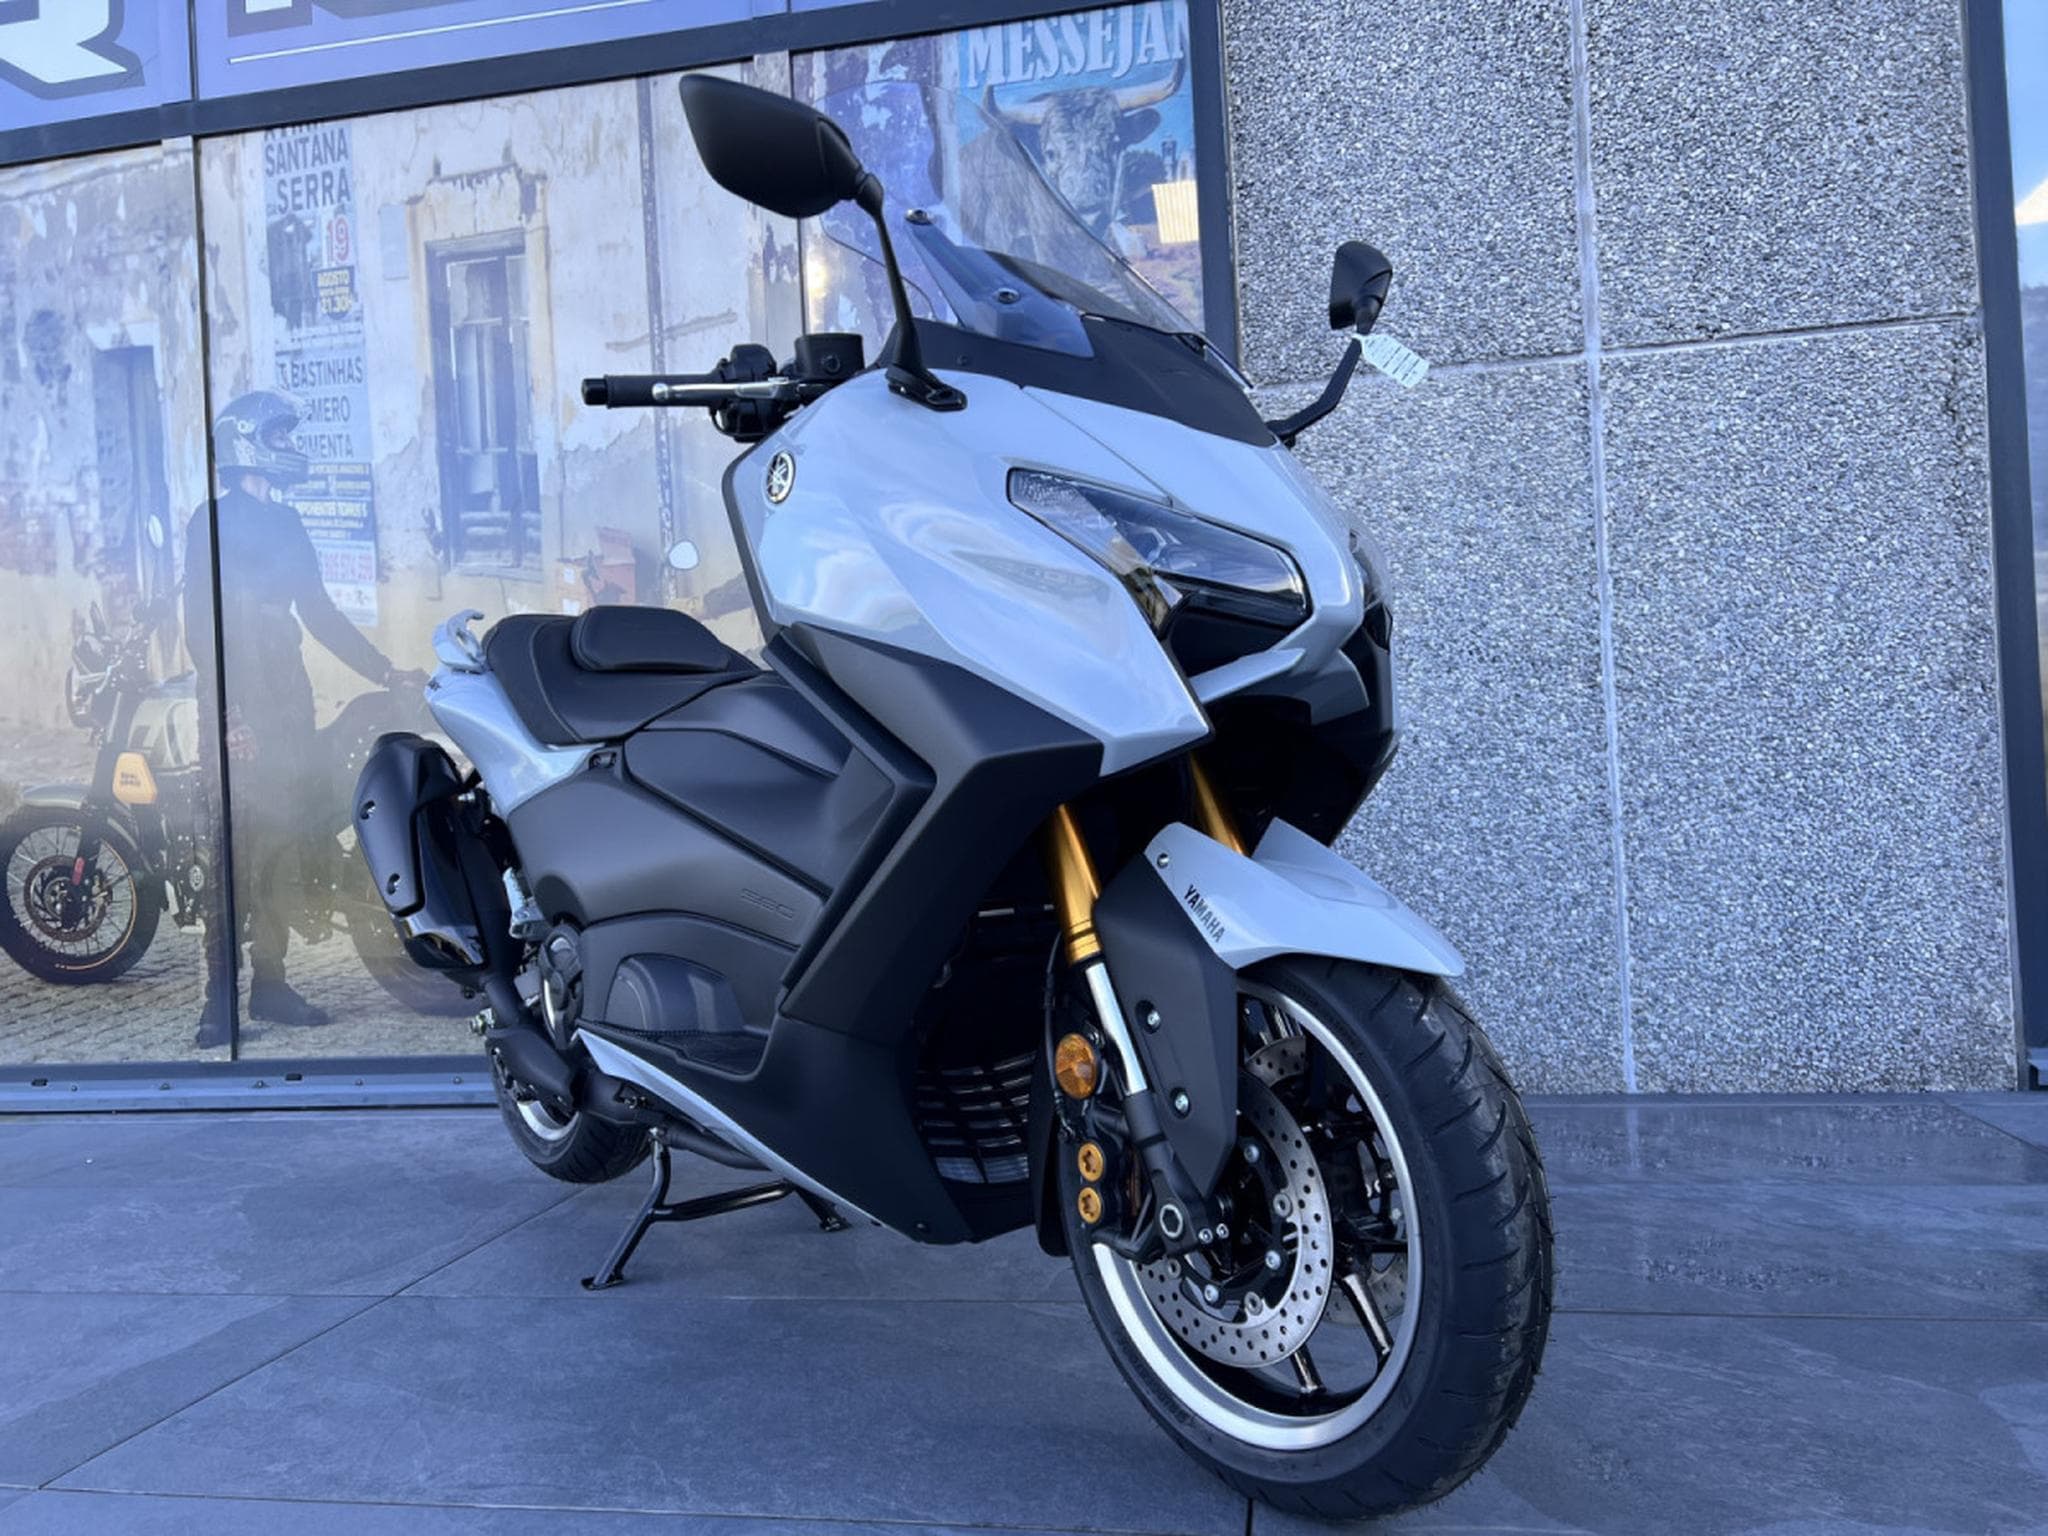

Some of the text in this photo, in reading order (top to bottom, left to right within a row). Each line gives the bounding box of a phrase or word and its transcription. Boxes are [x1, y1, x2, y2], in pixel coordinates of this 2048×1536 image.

[264, 127, 349, 178] SANTANA
[276, 166, 351, 215] SERRA
[326, 217, 349, 262] 19
[291, 356, 364, 388] BASTINHAS
[1184, 883, 1226, 943] YAMAHA
